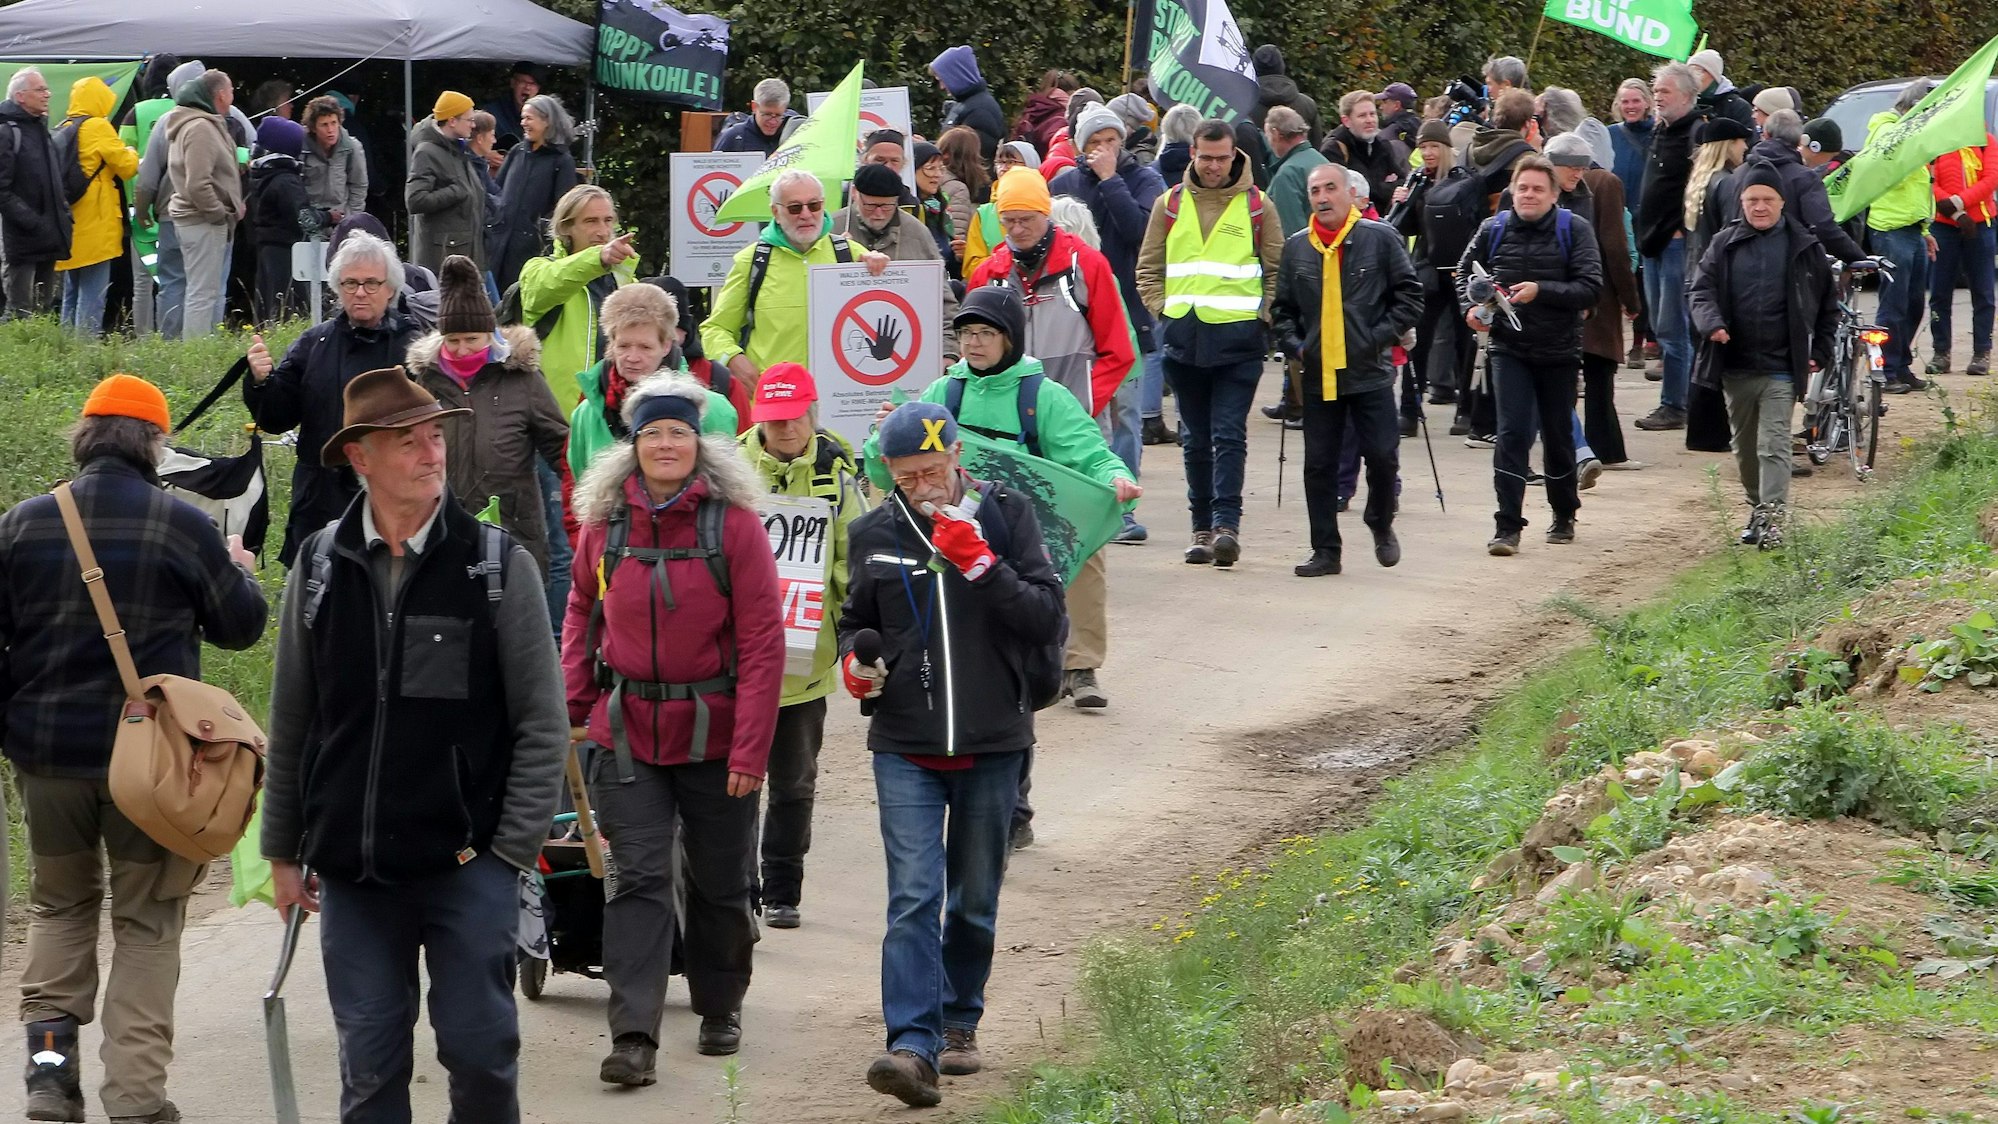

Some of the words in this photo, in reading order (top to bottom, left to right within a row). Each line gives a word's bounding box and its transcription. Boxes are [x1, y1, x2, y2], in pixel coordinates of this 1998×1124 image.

[599, 23, 655, 61] TOPPT
[1565, 0, 1671, 47] BUND
[597, 55, 720, 100] AUNKOHLE!
[872, 278, 910, 286] SCHOTTER
[758, 512, 828, 564] OPPT
